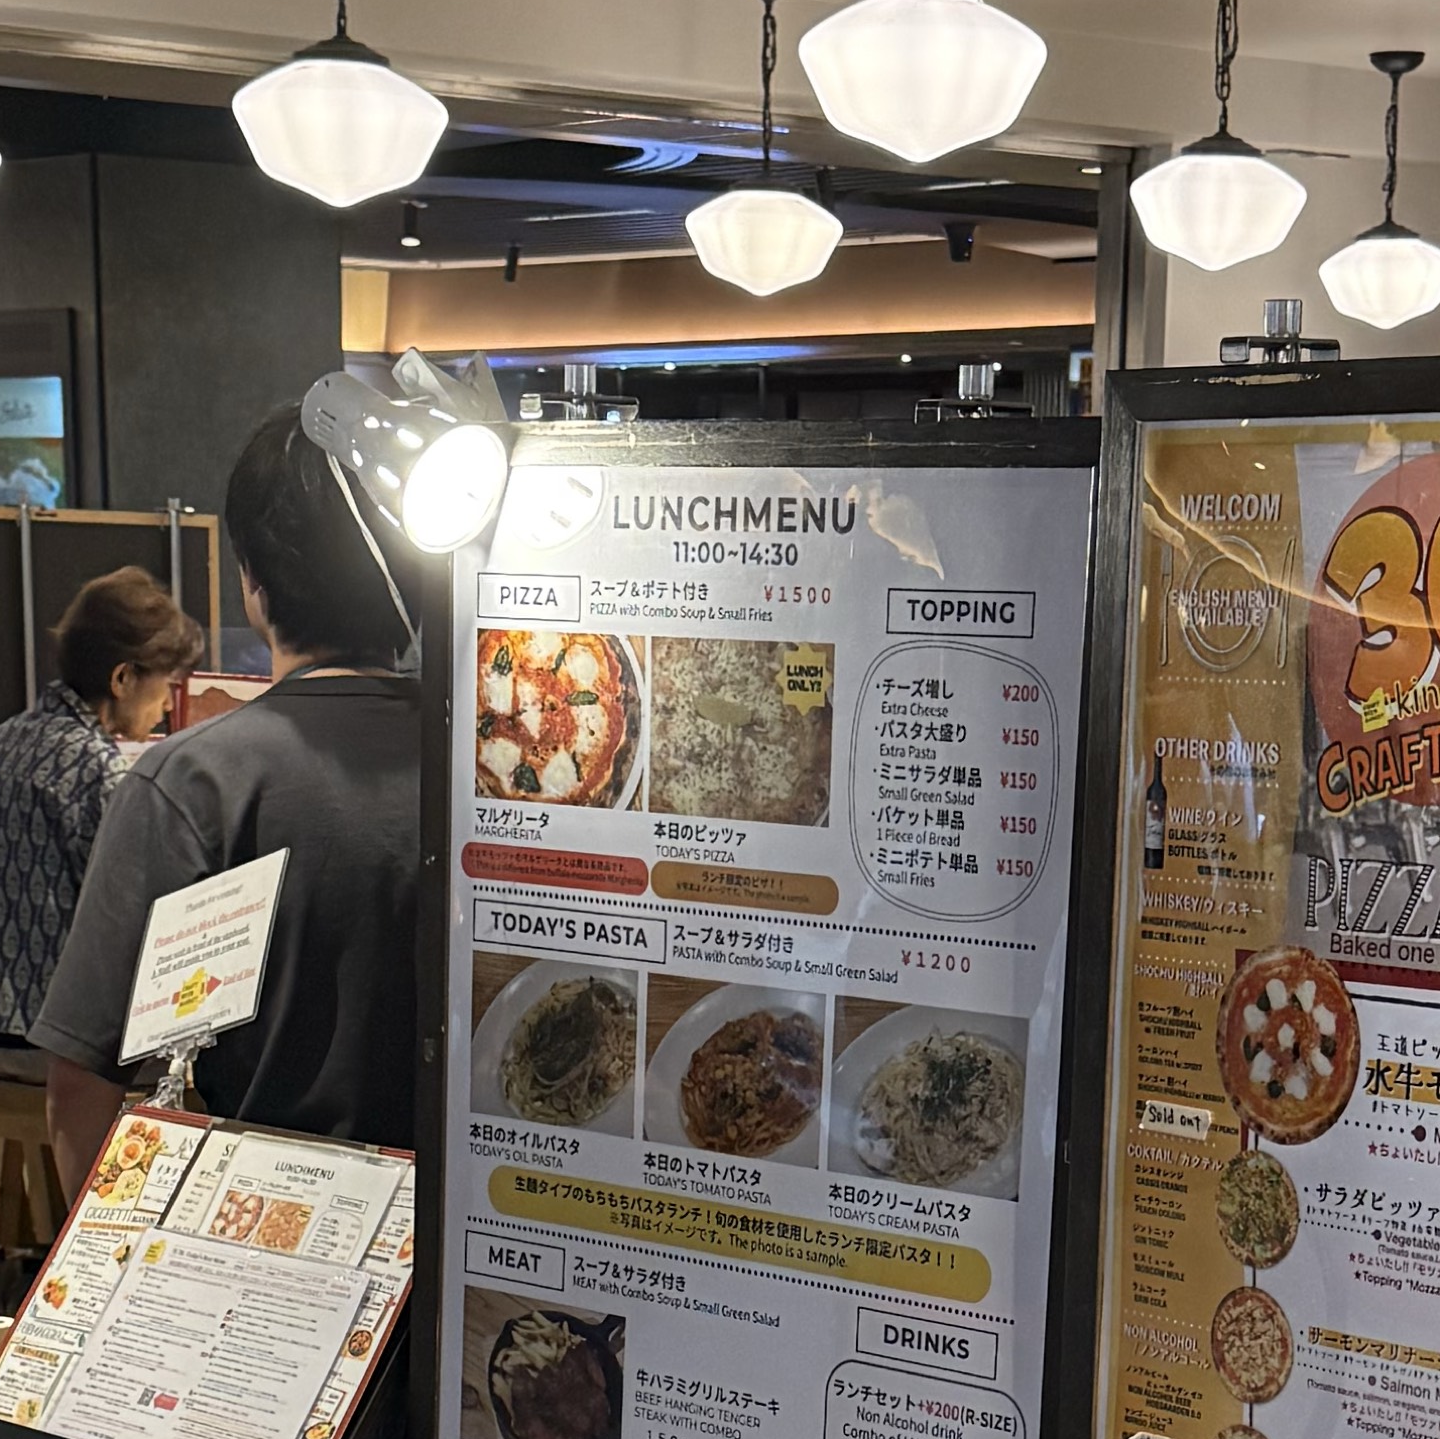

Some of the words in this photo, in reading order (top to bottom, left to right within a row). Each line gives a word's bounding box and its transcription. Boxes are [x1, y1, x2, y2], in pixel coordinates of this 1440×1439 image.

[614, 495, 856, 534] LUNCHMENU
[500, 586, 558, 607] PIZZA
[764, 585, 832, 604] ¥1500
[1169, 589, 1232, 608] ENGLISH
[1234, 590, 1279, 609] MENU
[907, 599, 1015, 624] TOPPING
[787, 665, 823, 677] LUNCH
[1003, 685, 1039, 702] ¥200
[910, 703, 949, 718] Cheese
[879, 720, 967, 743] パスタ大盛り
[1003, 729, 1039, 747] ¥150
[1155, 737, 1209, 761] OTHER
[1213, 738, 1280, 765] DRINKS
[879, 763, 982, 788] ミニサラダ単品
[1001, 772, 1037, 791] ¥150
[879, 787, 908, 802] Small
[910, 788, 942, 804] Green
[944, 789, 975, 806] Salad
[475, 807, 550, 829] マルゲリータ
[1000, 816, 1037, 835] ¥150
[702, 848, 736, 864] PIZZA
[876, 848, 979, 874] ミニポテト単品
[997, 859, 1033, 877] ¥150
[877, 870, 908, 885] Small
[910, 873, 935, 888] Fries
[491, 910, 577, 941] TODAY'S
[583, 922, 648, 949] PASTA
[1330, 933, 1392, 959] Baked
[1398, 943, 1435, 963] one
[901, 949, 972, 973] ¥1200
[1148, 1104, 1176, 1129] Sold
[469, 1123, 580, 1157] 本日のオイルパスタ
[643, 1151, 762, 1186] 本日のトマトパスタ
[828, 1182, 972, 1222] 本日のクリームパスタ
[488, 1245, 542, 1273] MEAT
[883, 1324, 970, 1359] DRINKS
[636, 1369, 780, 1415] 牛ハラミグリルステーキ
[1381, 1377, 1430, 1400] Salmon
[634, 1407, 667, 1424] STEAK
[700, 1420, 742, 1439] COMBO
[883, 1411, 929, 1434] Alcohol
